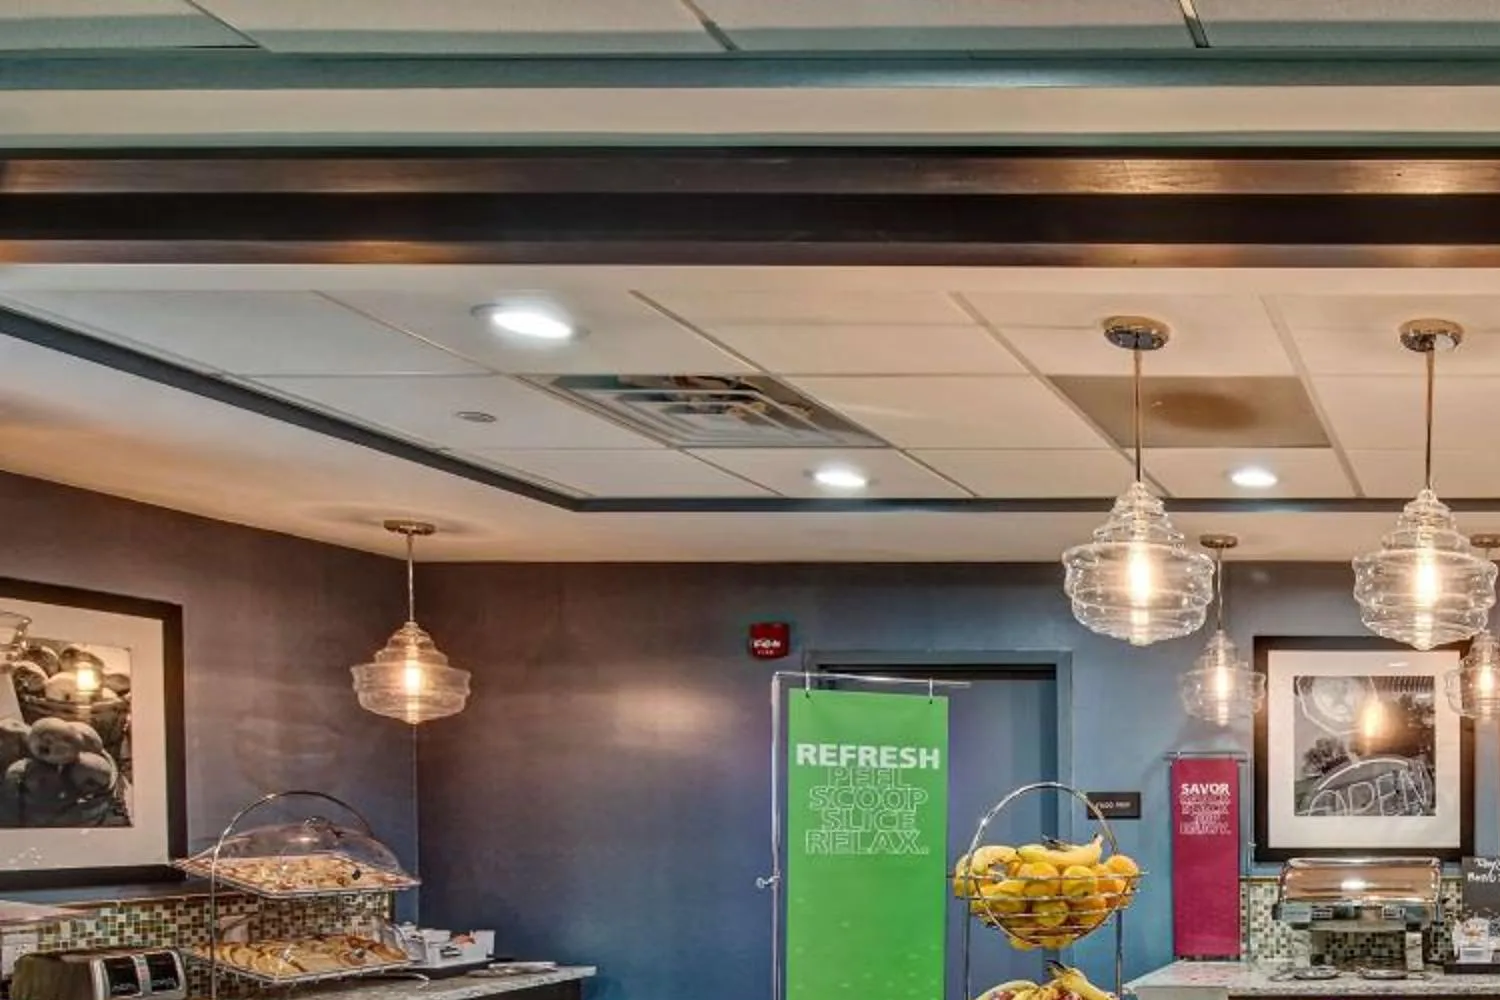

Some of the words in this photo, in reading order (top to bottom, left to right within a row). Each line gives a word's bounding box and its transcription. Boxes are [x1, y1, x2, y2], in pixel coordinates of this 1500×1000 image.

[796, 743, 940, 769] REFRESH
[809, 785, 929, 812] SCOOP
[1181, 783, 1231, 796] SAVOR
[821, 808, 917, 832] SLICE
[806, 829, 929, 855] RELAX.
